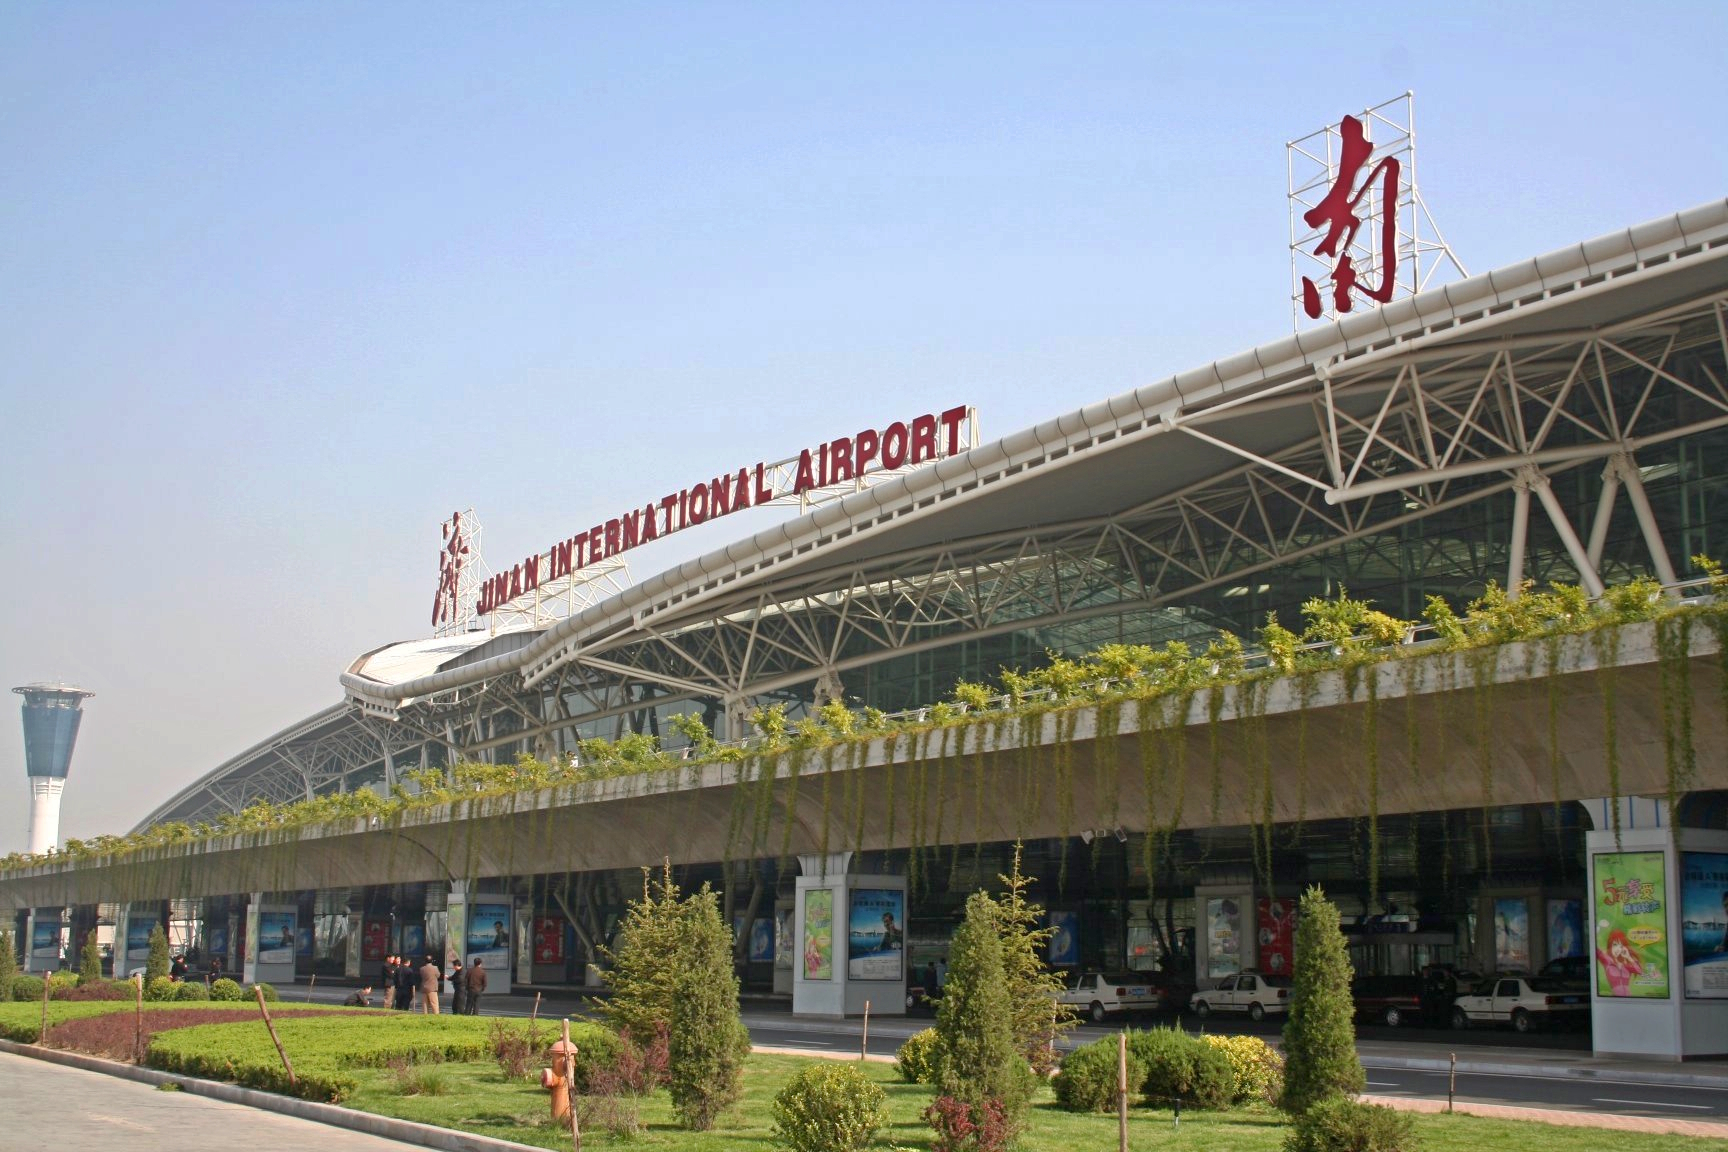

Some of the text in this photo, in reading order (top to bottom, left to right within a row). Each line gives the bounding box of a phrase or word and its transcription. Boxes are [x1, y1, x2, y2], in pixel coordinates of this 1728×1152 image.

[1302, 115, 1401, 319] 南
[477, 405, 967, 616] JINAN INTERNATIONAL AIRPORT
